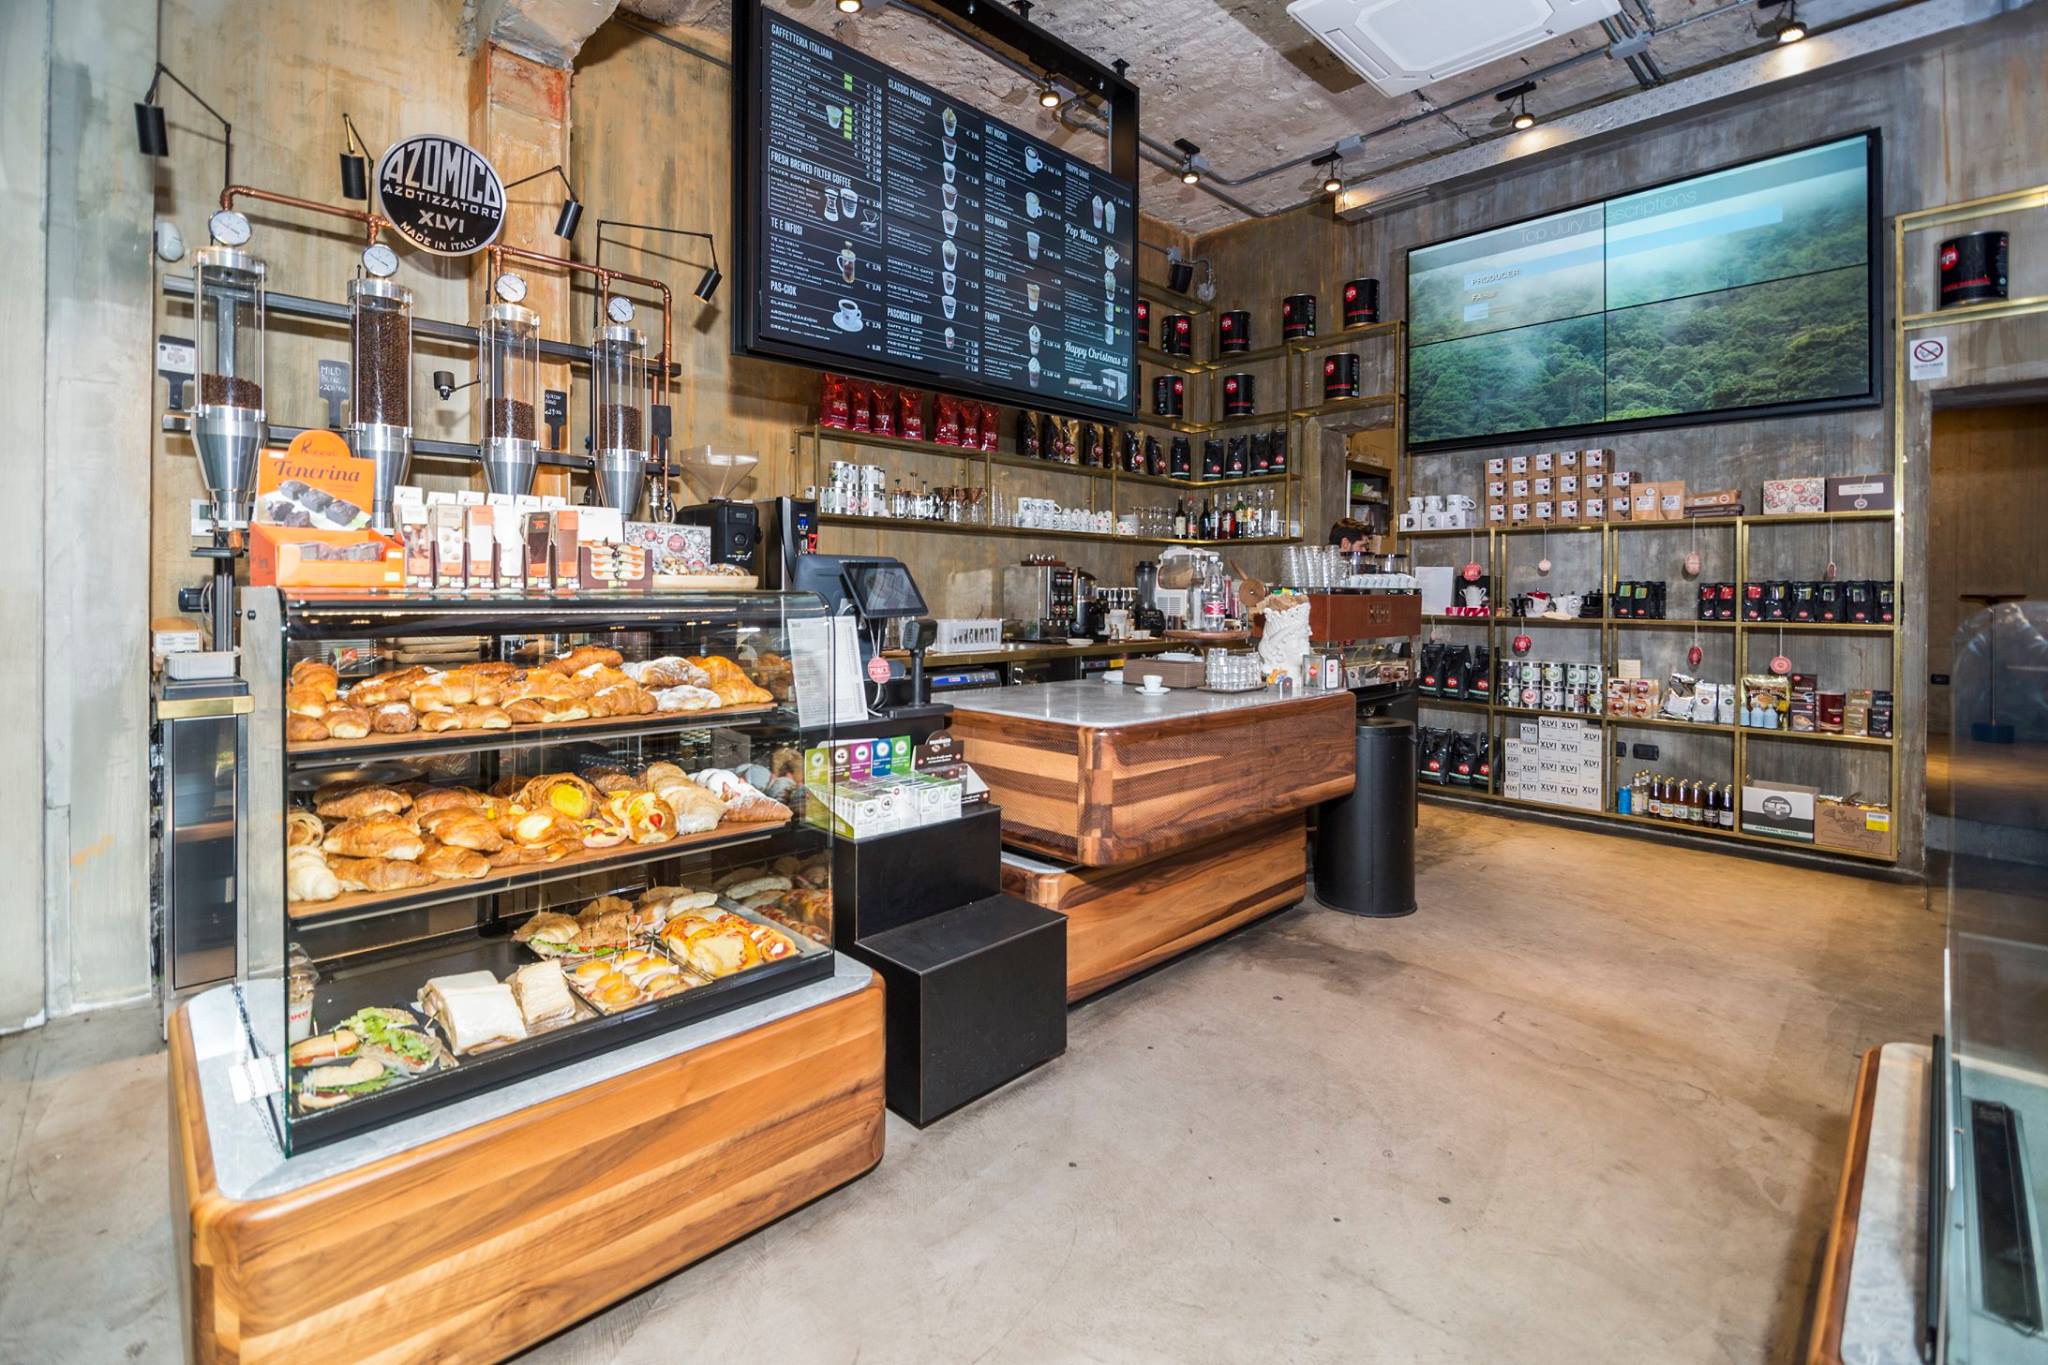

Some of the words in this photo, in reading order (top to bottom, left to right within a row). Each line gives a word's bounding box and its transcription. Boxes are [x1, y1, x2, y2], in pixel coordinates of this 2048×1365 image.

[771, 24, 808, 49] CAFFETTERIA
[809, 41, 833, 60] ITALIANA
[770, 151, 789, 165] FRESH
[790, 158, 813, 175] BREWED
[814, 164, 831, 182] FILTER
[832, 173, 851, 188] COFFEE
[771, 167, 789, 177] FILTER
[790, 173, 810, 184] COFFEE
[383, 183, 500, 220] AZOTIZZATORE
[418, 209, 465, 233] XLVI
[400, 221, 432, 246] MADE
[435, 240, 447, 250] IN
[451, 237, 477, 251] ITALY
[1519, 229, 1547, 245] Top
[1551, 220, 1584, 237] Jury
[1065, 341, 1088, 359] Happy
[1088, 347, 1121, 366] Christmas
[274, 460, 361, 483] Tenerina
[1541, 720, 1557, 728] XLVI
[1561, 721, 1578, 730] XLVI
[1584, 733, 1600, 741] XLVI
[1541, 741, 1557, 749] XLVI
[1561, 743, 1577, 752] XLVI
[1523, 747, 1536, 755] XLVI
[1541, 762, 1557, 771] XLVI
[1584, 759, 1599, 767] XLVI
[1561, 765, 1577, 773] XLVI
[1561, 786, 1578, 795] XLVI
[1583, 786, 1598, 794] XLVI
